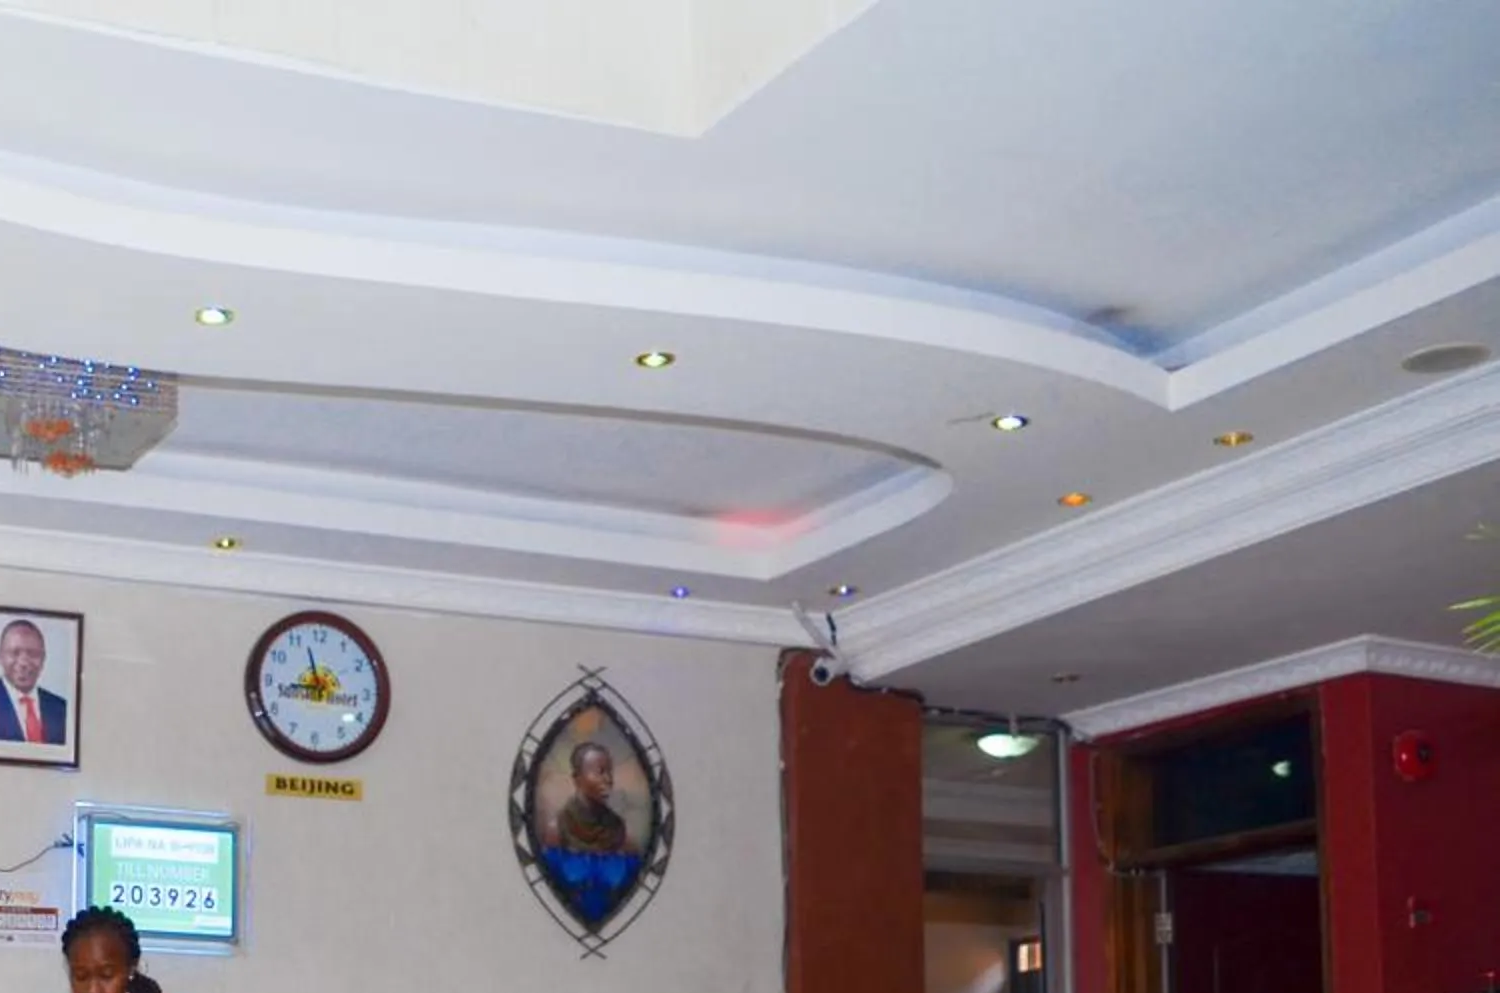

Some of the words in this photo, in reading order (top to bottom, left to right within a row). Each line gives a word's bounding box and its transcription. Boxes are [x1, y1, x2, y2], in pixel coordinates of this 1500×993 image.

[289, 634, 301, 647] 11
[312, 630, 327, 644] 12
[340, 641, 346, 652] 1
[271, 650, 287, 664] 10
[355, 659, 364, 672] 2
[264, 673, 273, 687] 9
[363, 688, 370, 701] 3
[355, 711, 363, 723] 4
[289, 722, 298, 735] 7
[337, 726, 346, 739] 5
[275, 776, 355, 796] BEIJING
[112, 884, 215, 909] 203926
